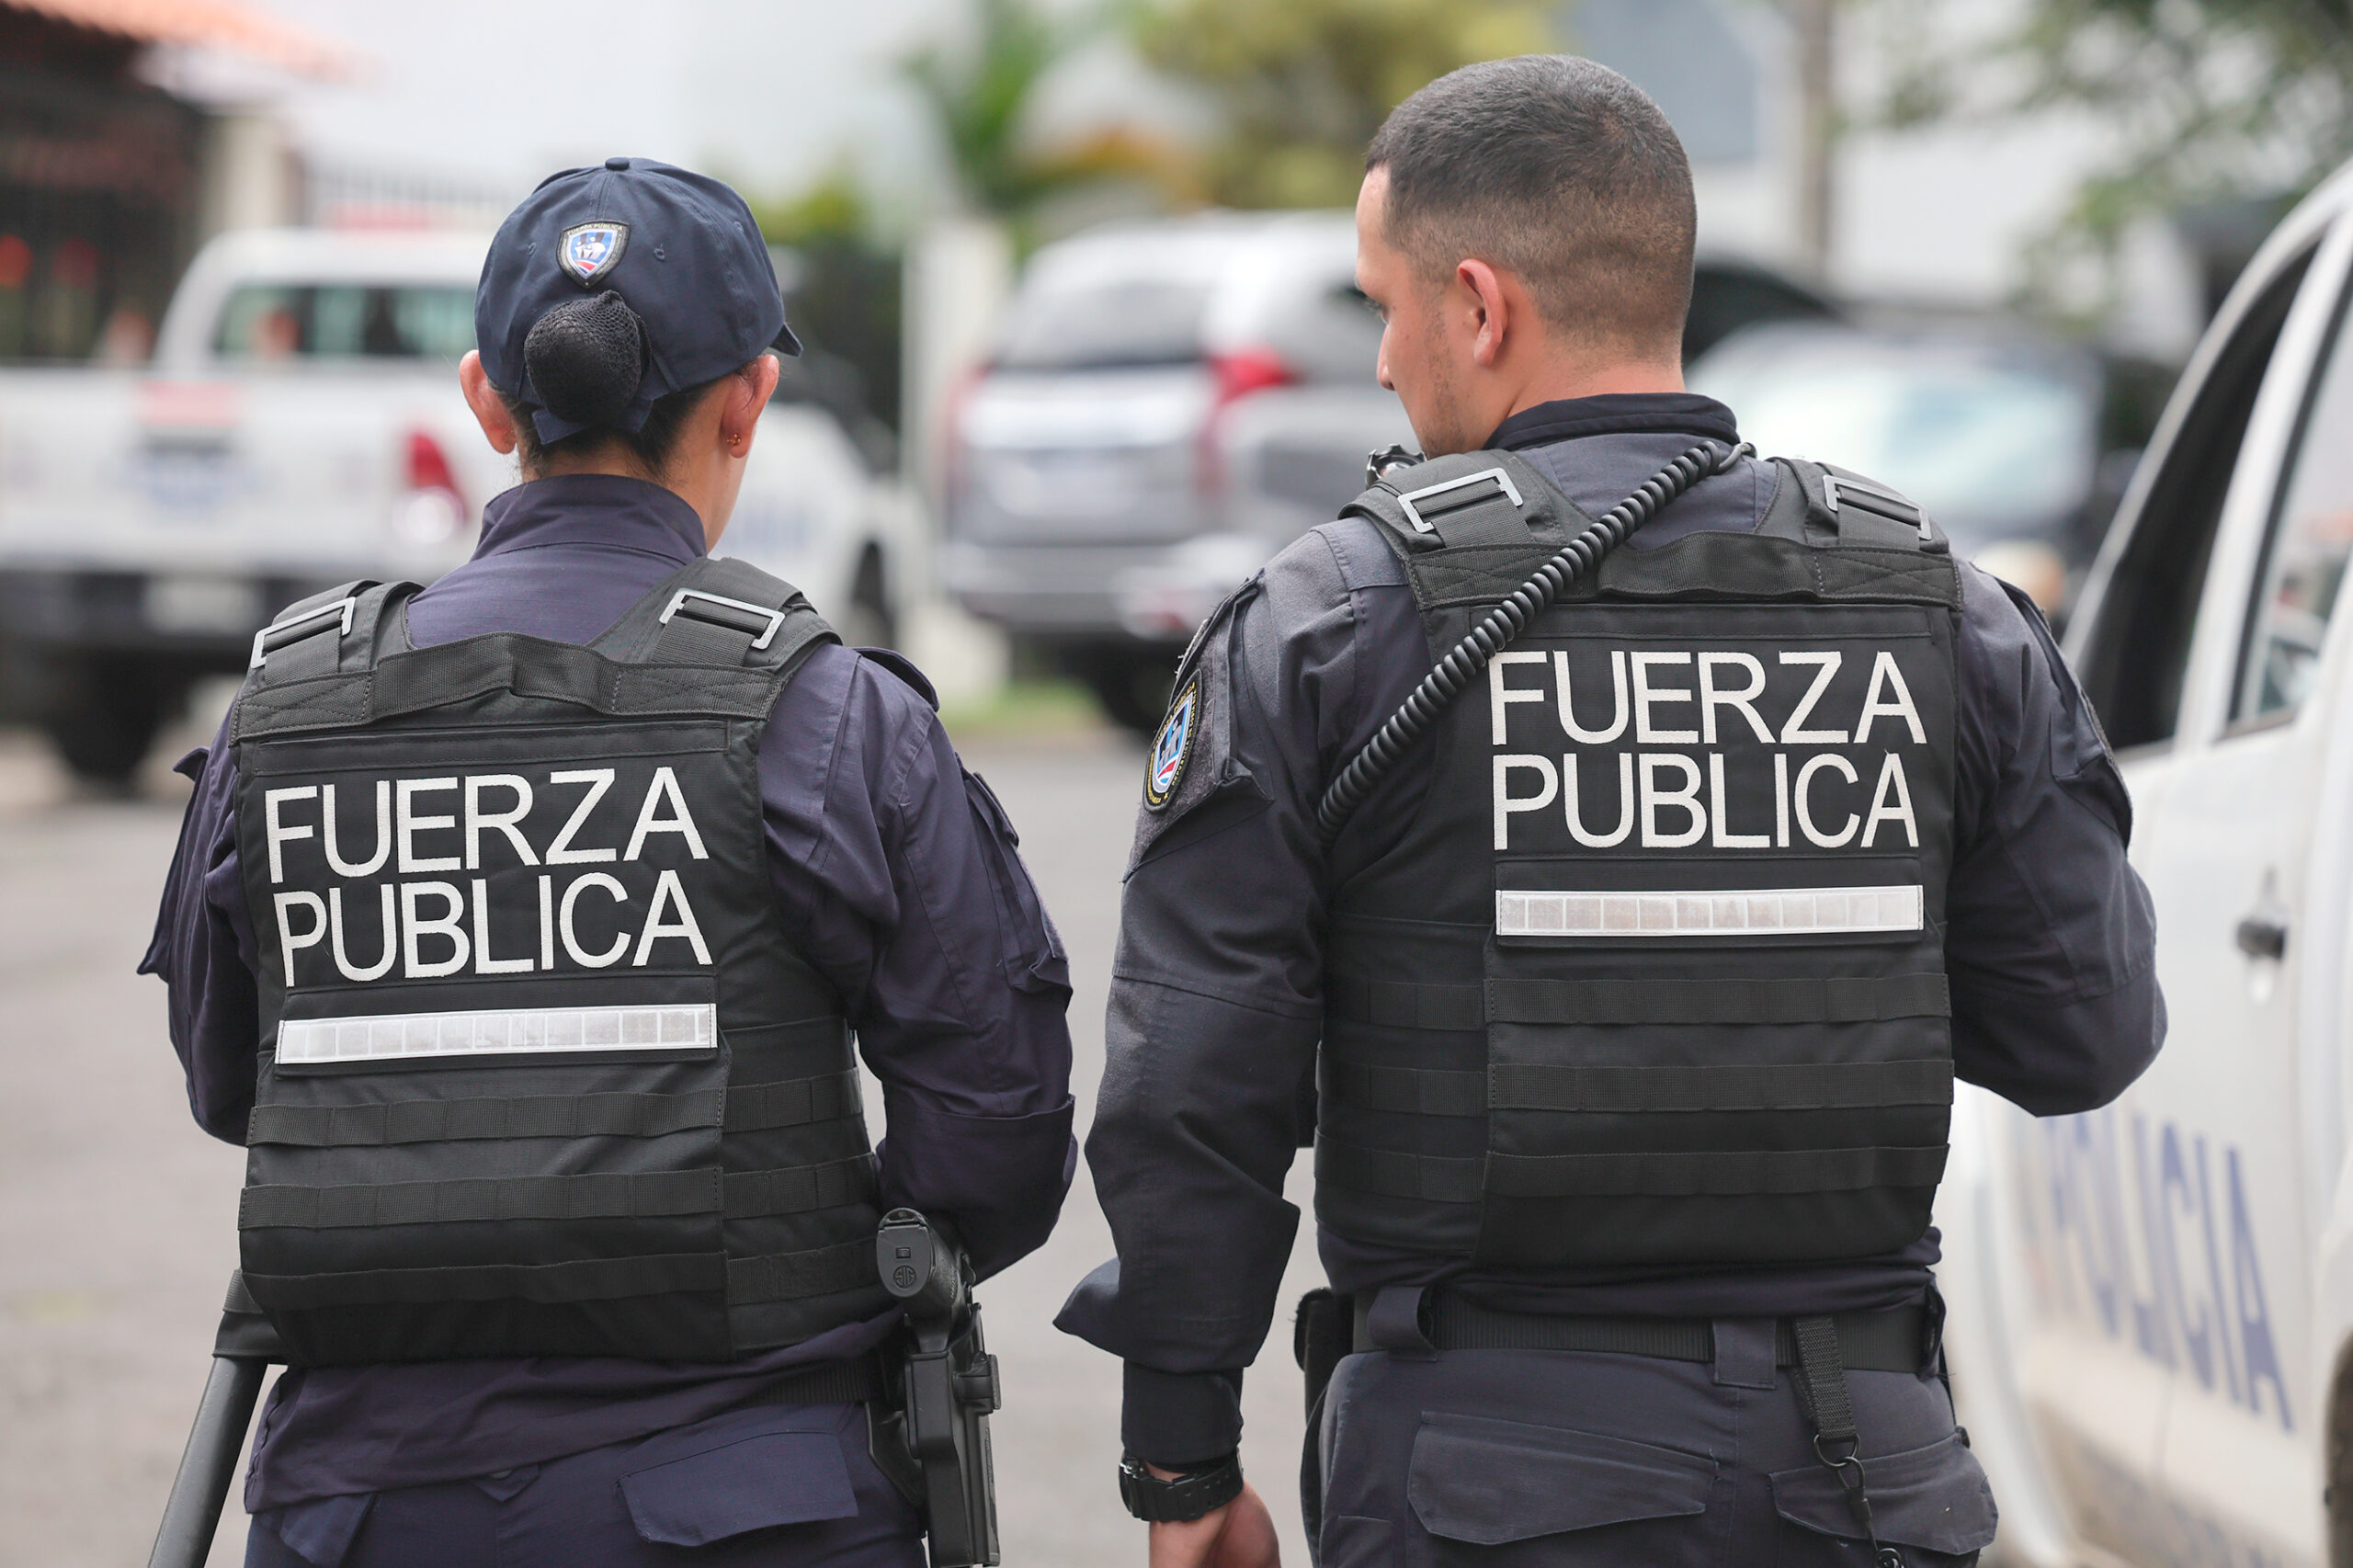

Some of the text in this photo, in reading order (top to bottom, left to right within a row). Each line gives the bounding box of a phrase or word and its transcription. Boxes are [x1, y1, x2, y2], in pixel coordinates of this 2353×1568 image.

[1490, 651, 1927, 745] FUERZA
[266, 767, 710, 884] FUERZA
[1493, 751, 1919, 850] PUBLICA
[274, 870, 713, 988] PUBLICA
